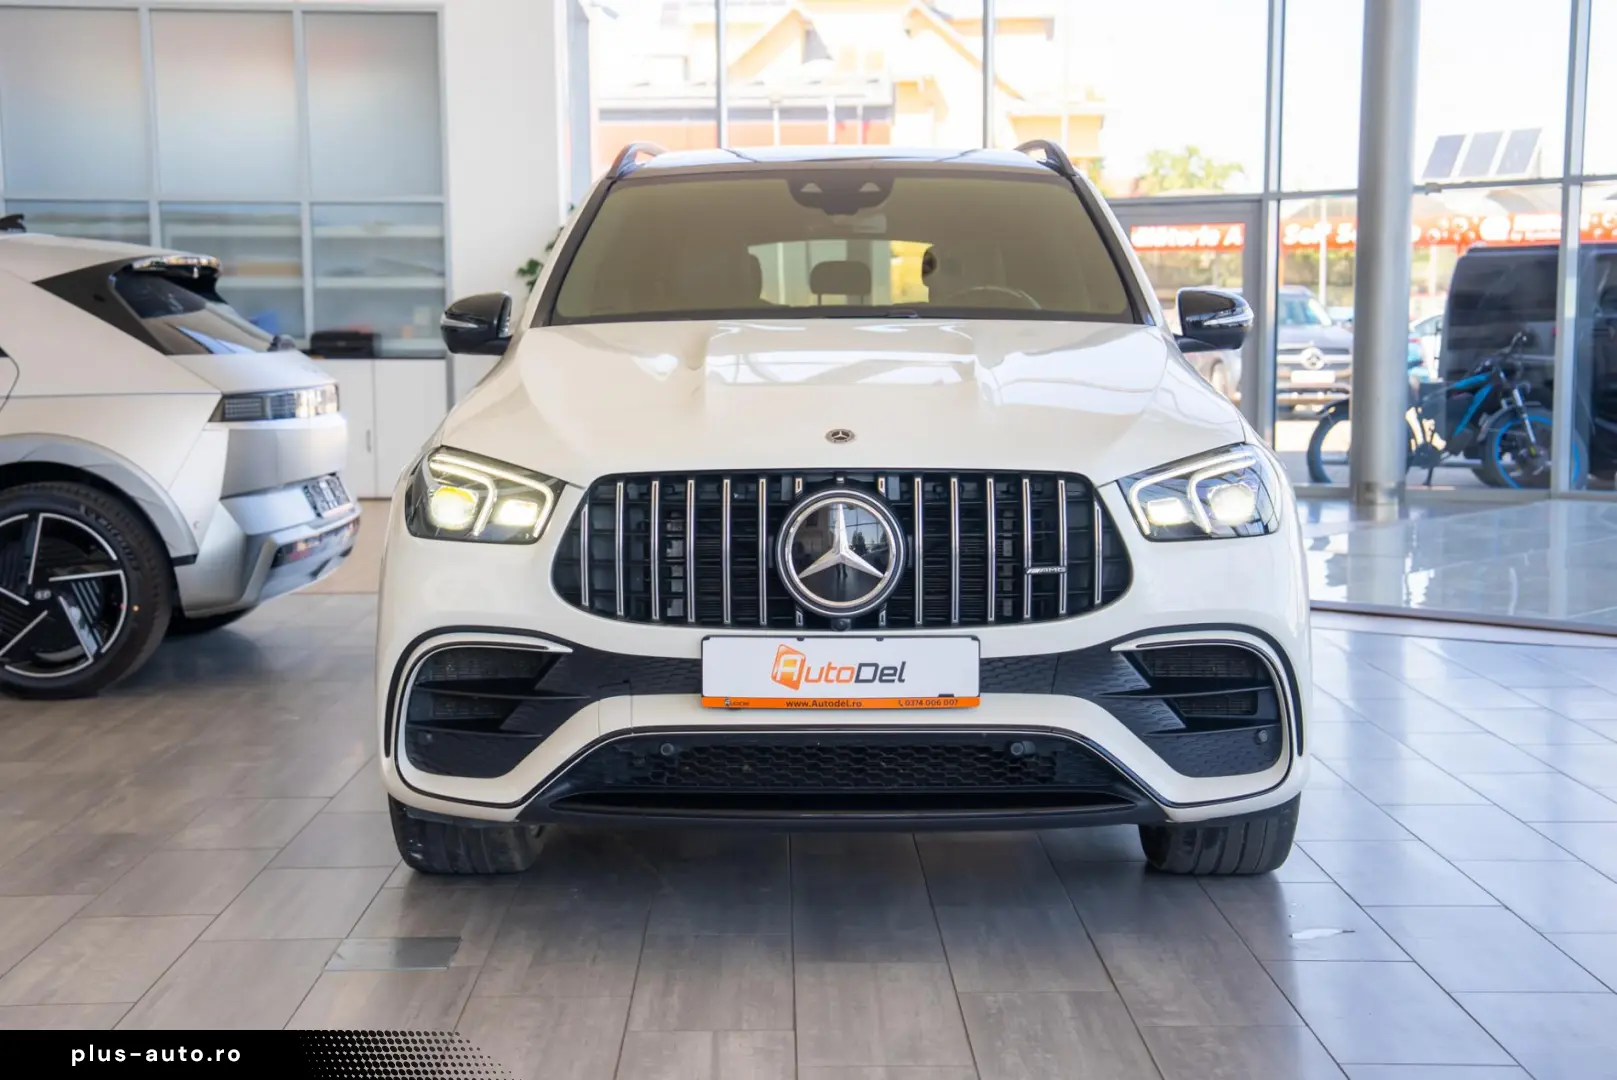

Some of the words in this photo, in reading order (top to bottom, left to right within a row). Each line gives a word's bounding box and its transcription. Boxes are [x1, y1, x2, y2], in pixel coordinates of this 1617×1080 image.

[773, 650, 906, 686] AutoDel
[785, 699, 862, 708] www.Autodel.ro
[905, 698, 924, 707] 0374
